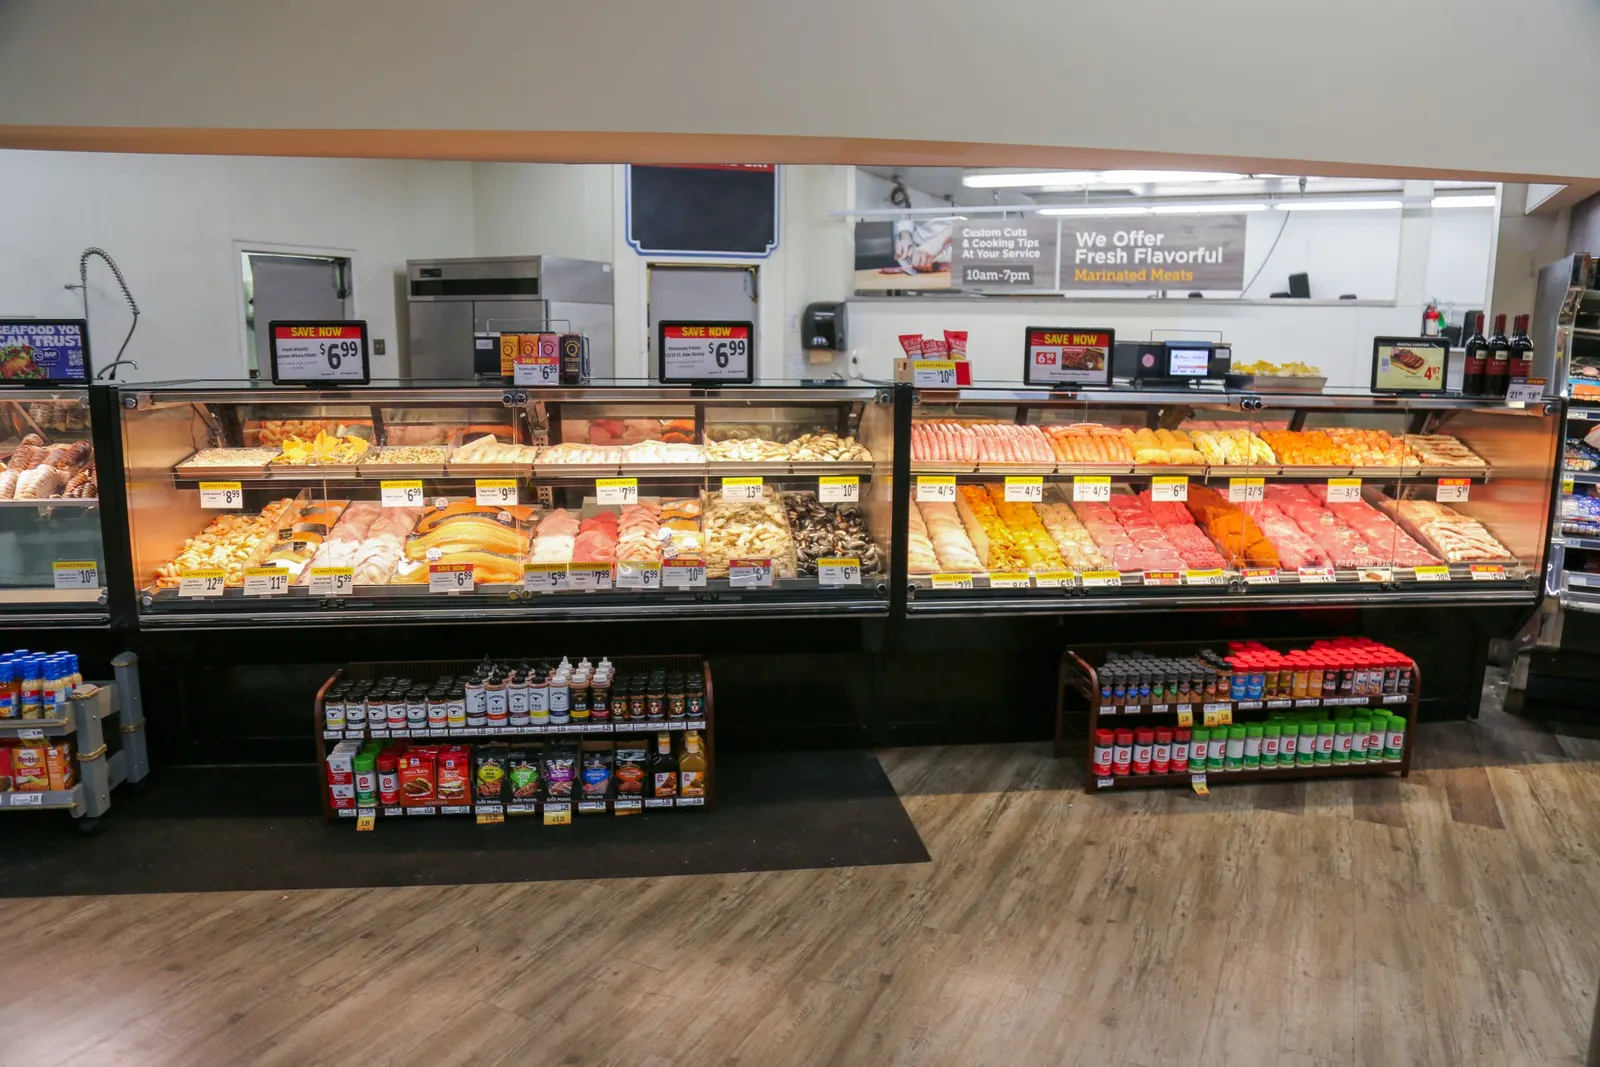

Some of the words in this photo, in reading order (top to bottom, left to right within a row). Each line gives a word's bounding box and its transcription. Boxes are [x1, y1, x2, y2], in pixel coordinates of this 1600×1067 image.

[963, 228, 1001, 237] Custom
[1004, 228, 1027, 237] Cuts
[962, 239, 970, 248] &
[972, 239, 1015, 249] Cooking
[1018, 238, 1040, 249] Tips
[1076, 231, 1107, 247] We
[1113, 230, 1165, 247] Offer
[962, 249, 974, 258] At
[977, 249, 1000, 258] Your
[1003, 249, 1041, 258] Service
[1075, 248, 1128, 264] Fresh
[1134, 247, 1223, 264] Flavorful
[966, 269, 1030, 283] 10am-7pm
[1074, 268, 1147, 281] Marinated
[1151, 268, 1194, 281] Meats
[291, 327, 315, 337] SAVE
[319, 327, 342, 337] NOW
[681, 327, 705, 337] SAVE
[708, 327, 732, 337] NOW
[32, 335, 82, 347] TRUST
[1044, 334, 1069, 344] SAVE
[1073, 335, 1097, 345] NOW
